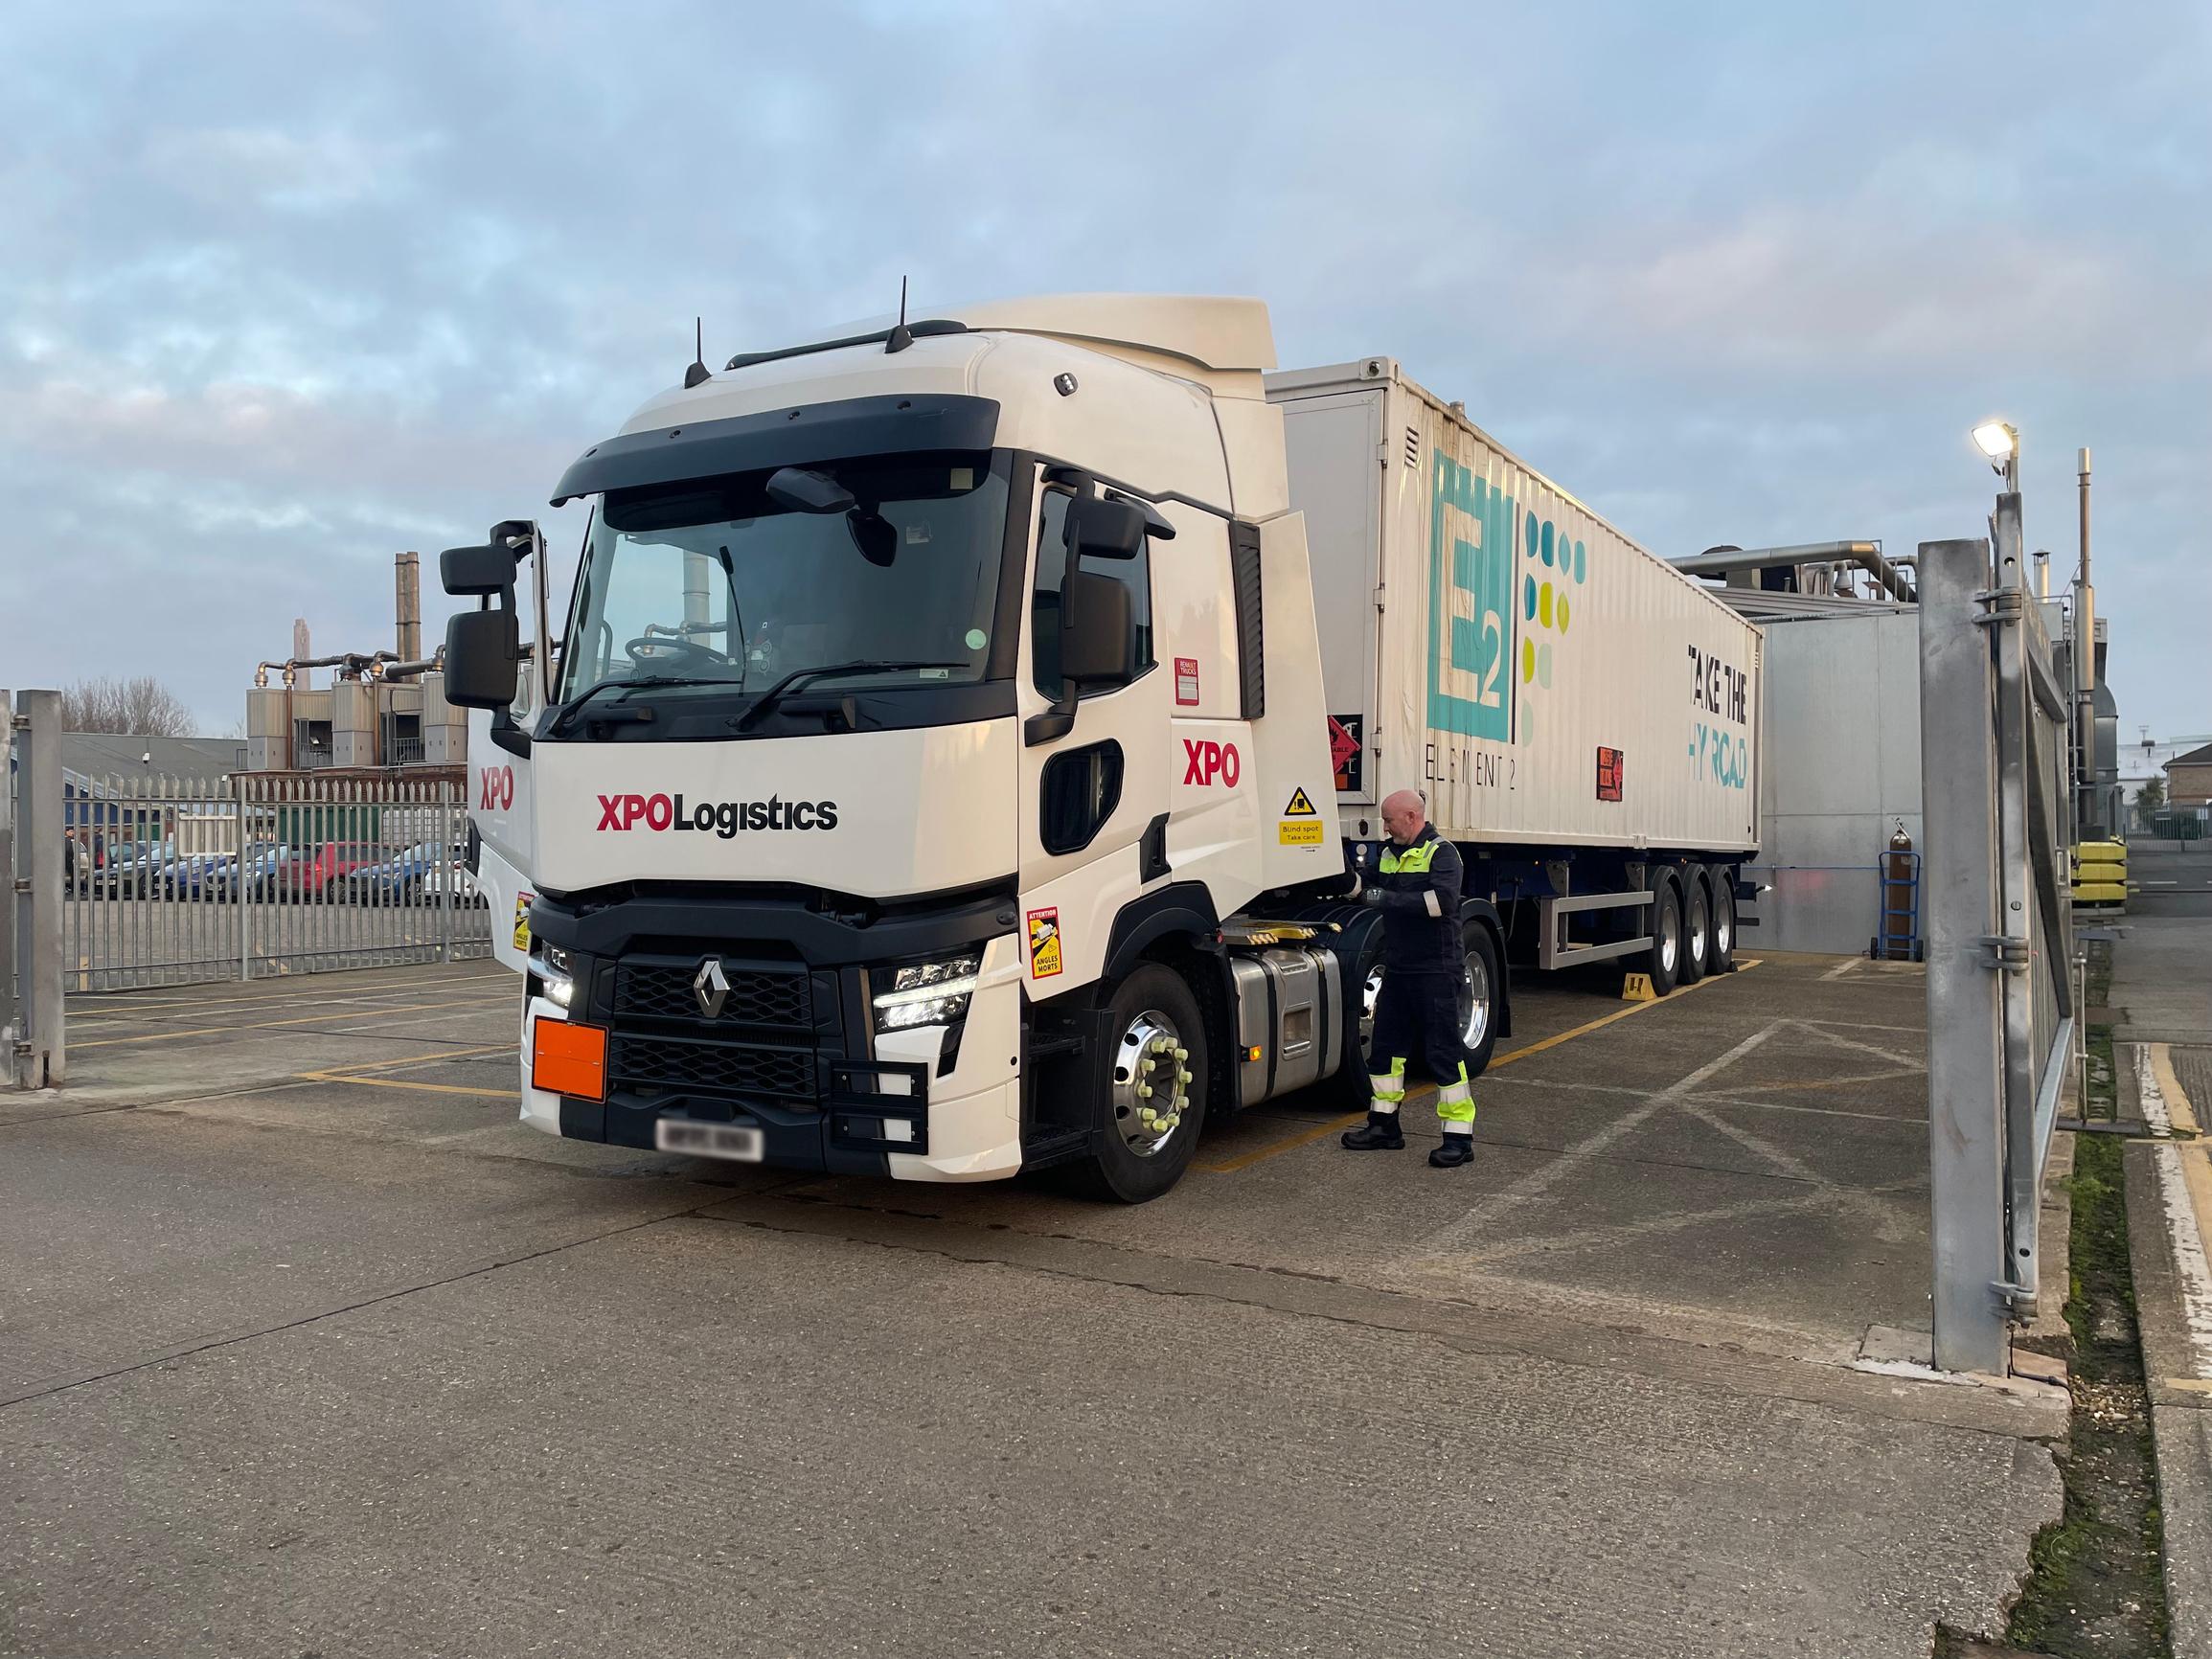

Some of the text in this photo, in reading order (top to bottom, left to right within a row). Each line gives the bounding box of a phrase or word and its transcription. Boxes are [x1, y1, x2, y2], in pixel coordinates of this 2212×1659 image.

[1439, 501, 1501, 709] E2
[1179, 660, 1197, 669] RENAULT
[1688, 645, 1747, 725] TAKE THE
[1183, 739, 1241, 788] XPO
[480, 765, 513, 811] XPO
[1029, 909, 1057, 920] ATTENTION
[1037, 955, 1059, 966] ANGLES
[1038, 963, 1059, 973] MORTS
